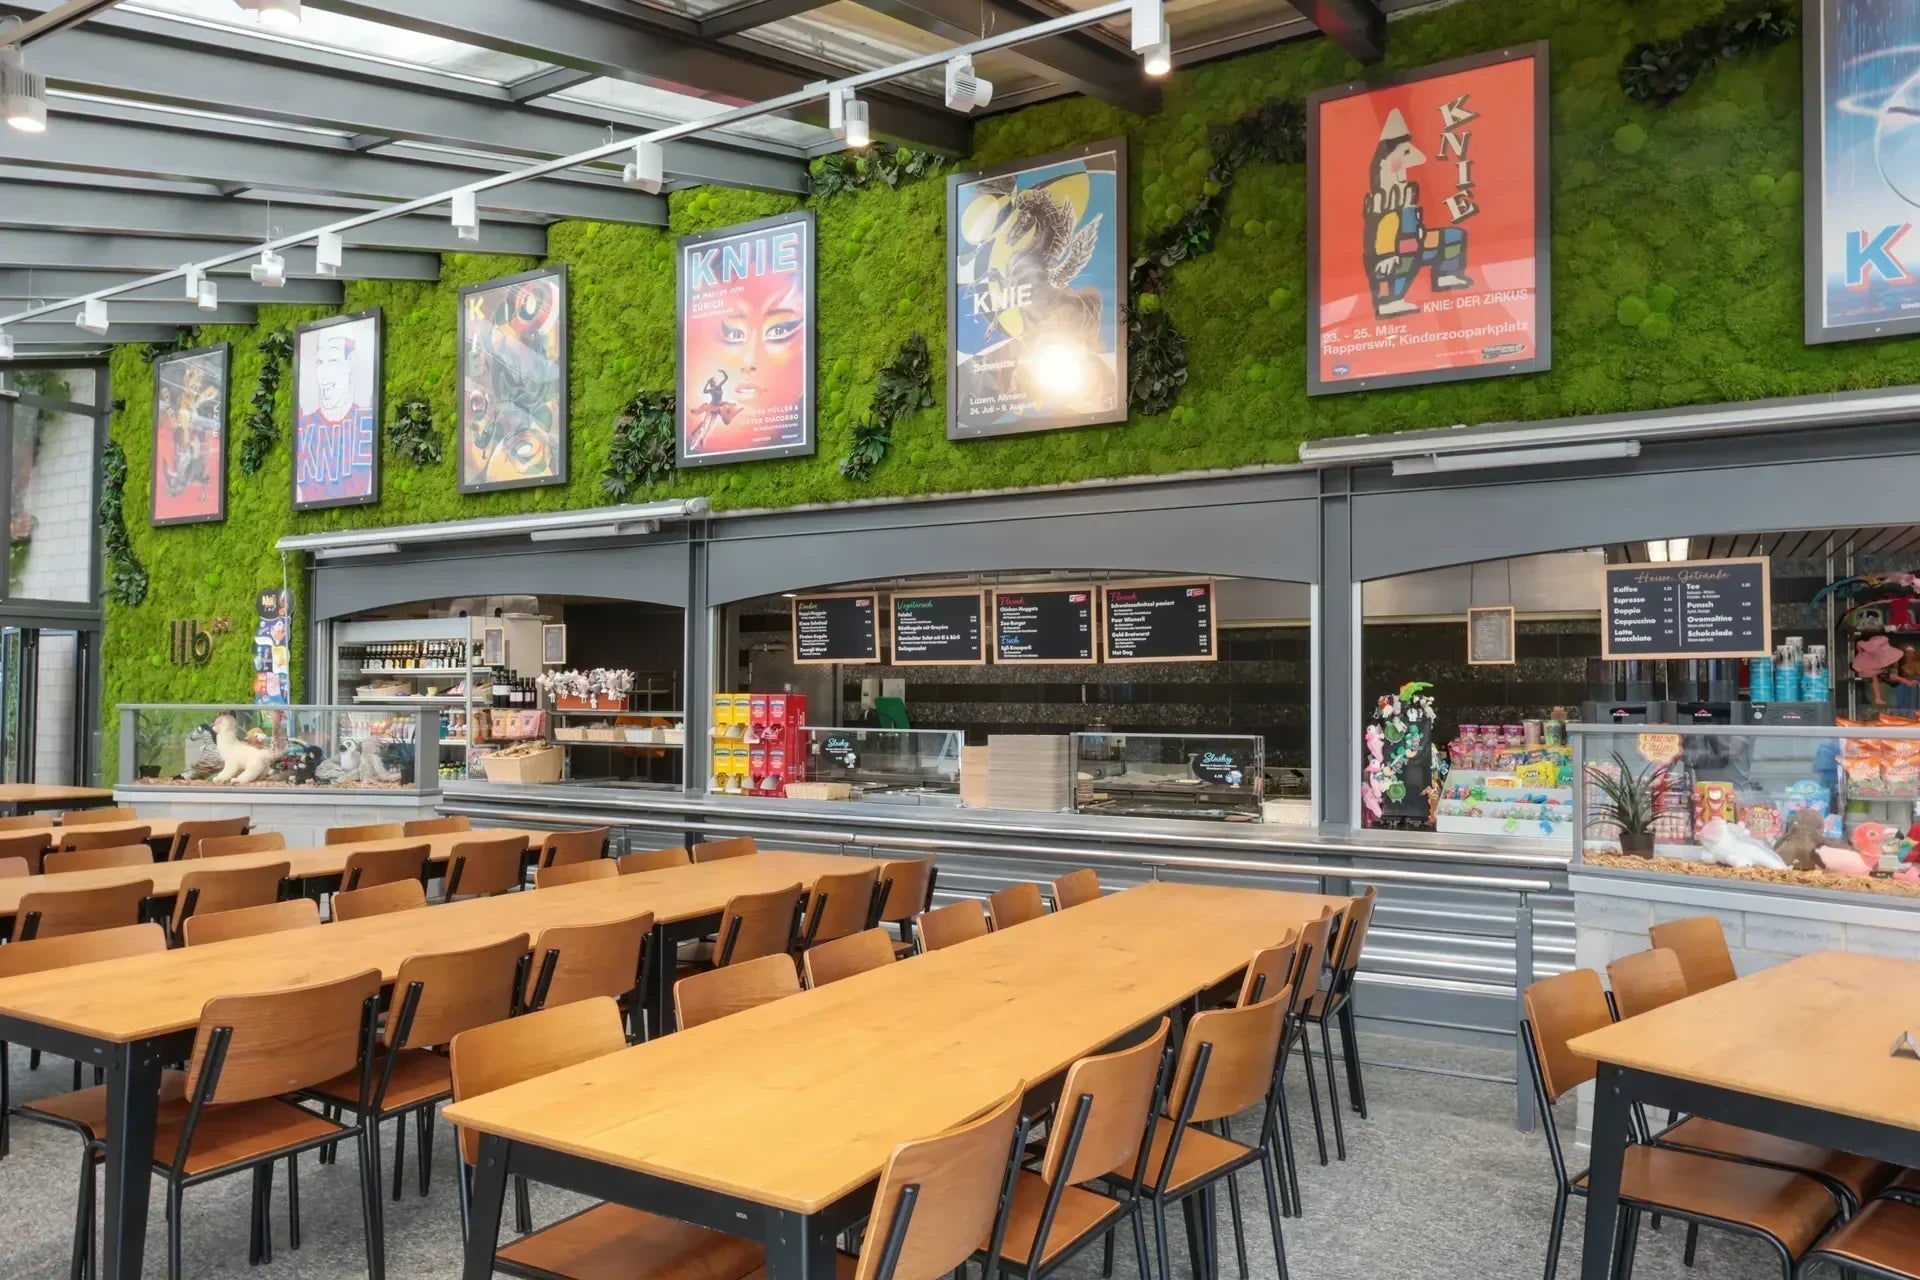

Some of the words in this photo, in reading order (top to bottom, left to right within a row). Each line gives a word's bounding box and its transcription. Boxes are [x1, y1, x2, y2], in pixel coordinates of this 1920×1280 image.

[1436, 94, 1480, 223] KNIE
[691, 232, 799, 290] KNIE
[973, 283, 1032, 315] KNIE
[1423, 300, 1452, 313] KNIE:
[1456, 296, 1480, 309] DER
[1483, 289, 1528, 305] ZIRKUS
[1323, 333, 1341, 344] 23.
[1354, 328, 1371, 339] 25.
[1375, 324, 1407, 337] März
[1323, 336, 1396, 355] Rapperswil,
[1399, 321, 1528, 346] Kinderzooparkplatz
[998, 392, 1027, 402] Allmend
[970, 407, 981, 415] 24.
[981, 405, 995, 414] Juli
[297, 407, 372, 483] KNIE
[1613, 585, 1638, 593] Kaffee
[1155, 600, 1175, 608] paniert
[1613, 597, 1646, 605] Espresso
[1686, 601, 1714, 609] Punsch
[1613, 607, 1641, 616] Doppio
[1614, 617, 1657, 626] Cappuccino
[1687, 614, 1733, 623] Ovomaltine
[1687, 628, 1734, 637] Schokolade
[827, 738, 850, 748] Slushy
[1202, 752, 1233, 764] Slushy
